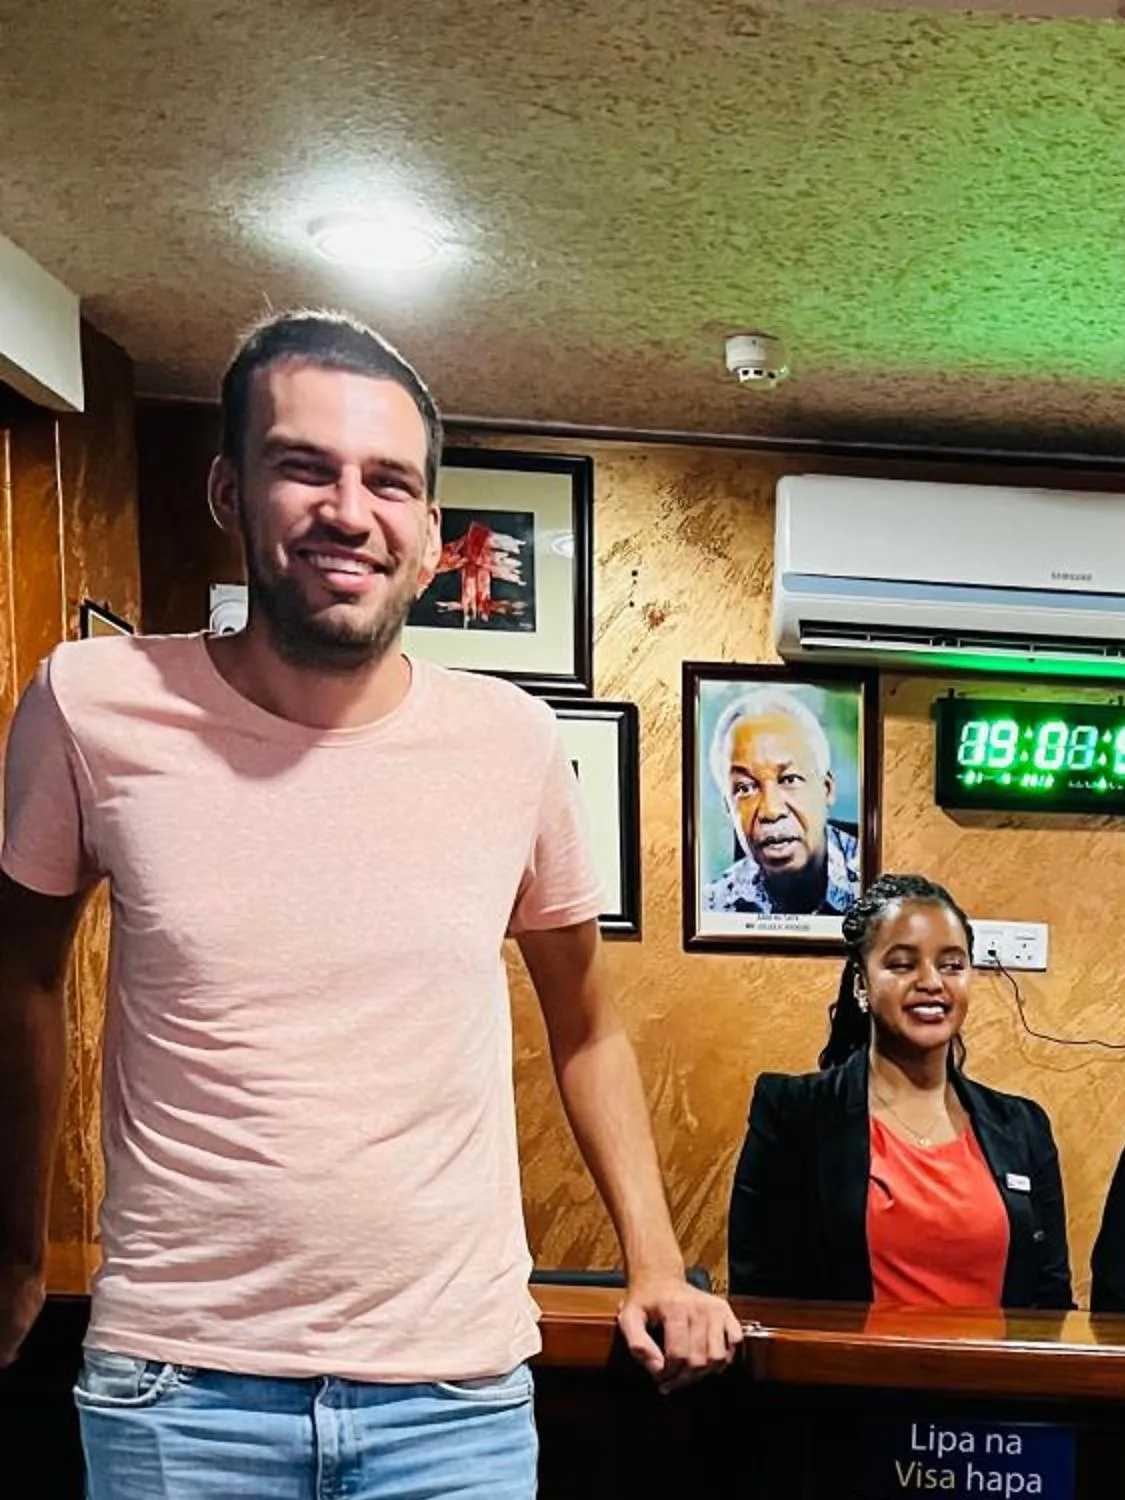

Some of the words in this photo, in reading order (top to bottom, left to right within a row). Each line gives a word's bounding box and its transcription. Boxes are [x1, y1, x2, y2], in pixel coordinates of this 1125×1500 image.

[911, 1423, 975, 1459] Lipa
[985, 1431, 1022, 1455] na
[895, 1460, 955, 1489] Visa
[966, 1462, 1042, 1499] hapa
